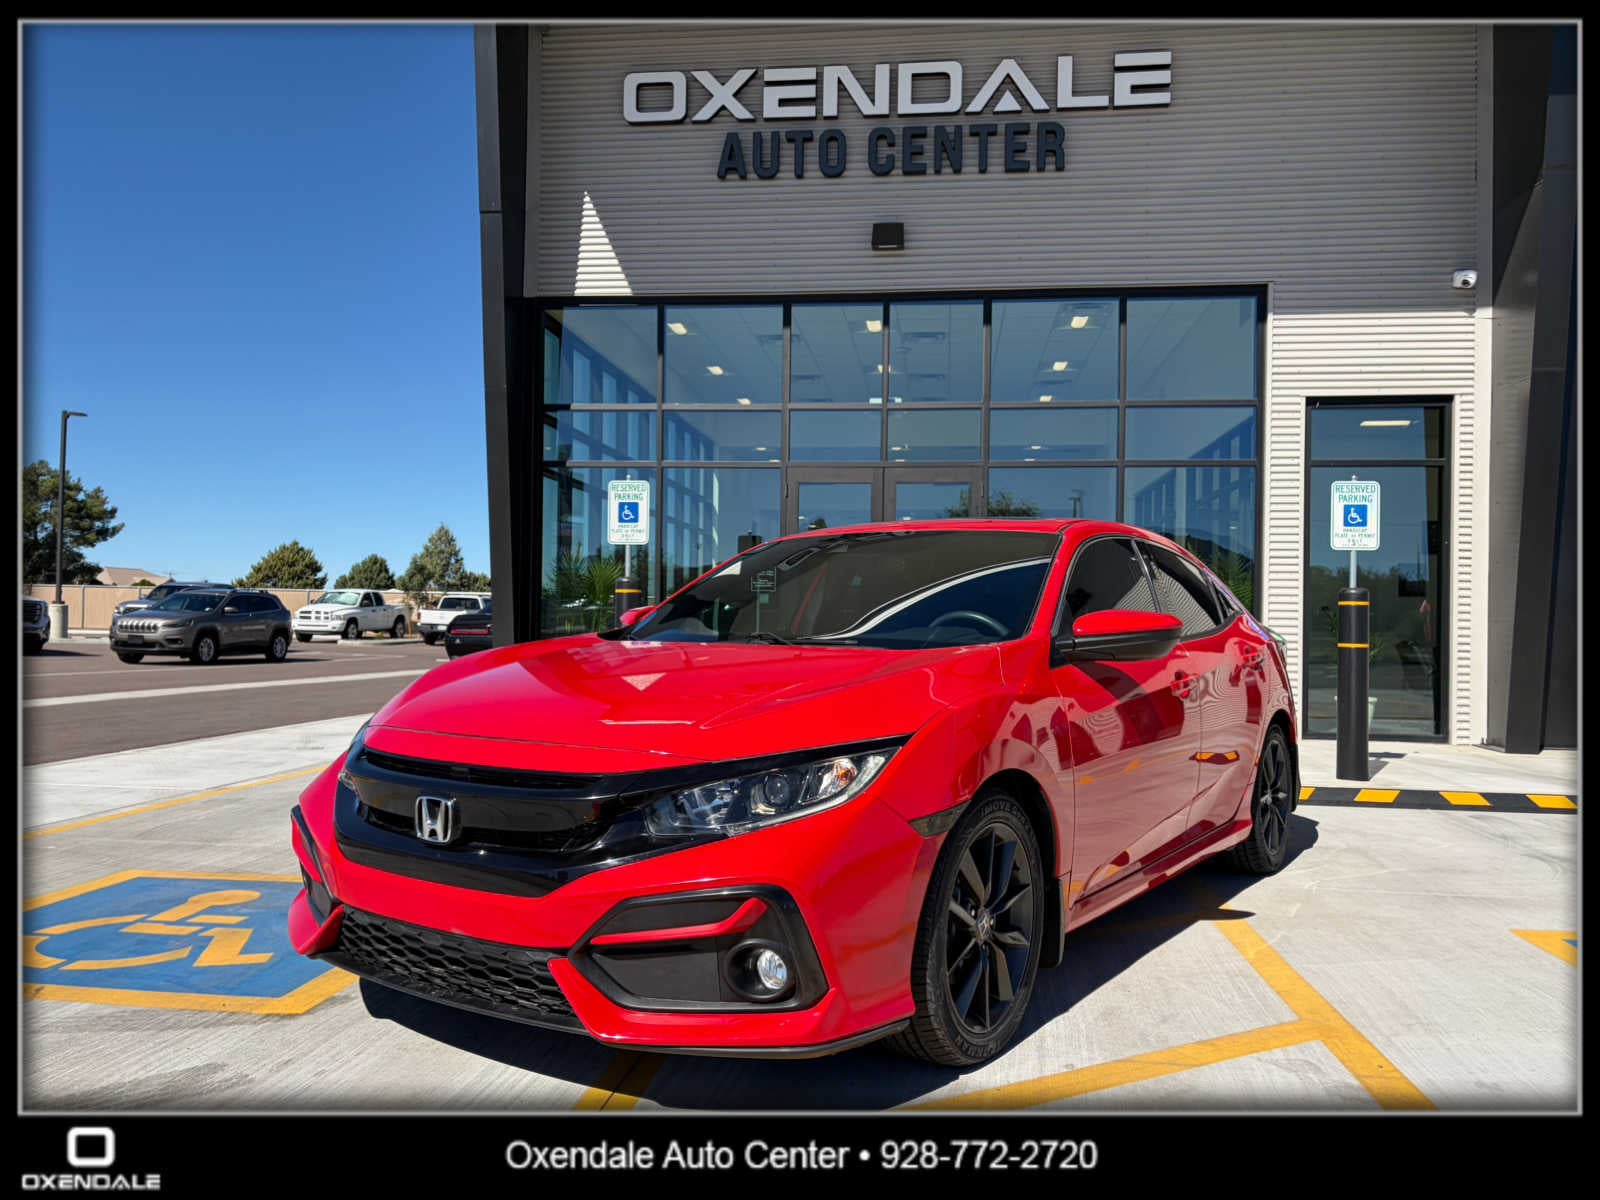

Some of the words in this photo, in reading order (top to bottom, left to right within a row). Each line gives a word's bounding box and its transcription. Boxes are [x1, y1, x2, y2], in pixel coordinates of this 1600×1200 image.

[622, 50, 1173, 125] OXENDALE
[716, 127, 848, 180] AUTO
[867, 121, 1067, 177] CENTER
[611, 483, 647, 492] RESERVED
[1335, 484, 1376, 494] RESERVED
[614, 492, 644, 501] PARKING
[1338, 494, 1373, 504] PARKING
